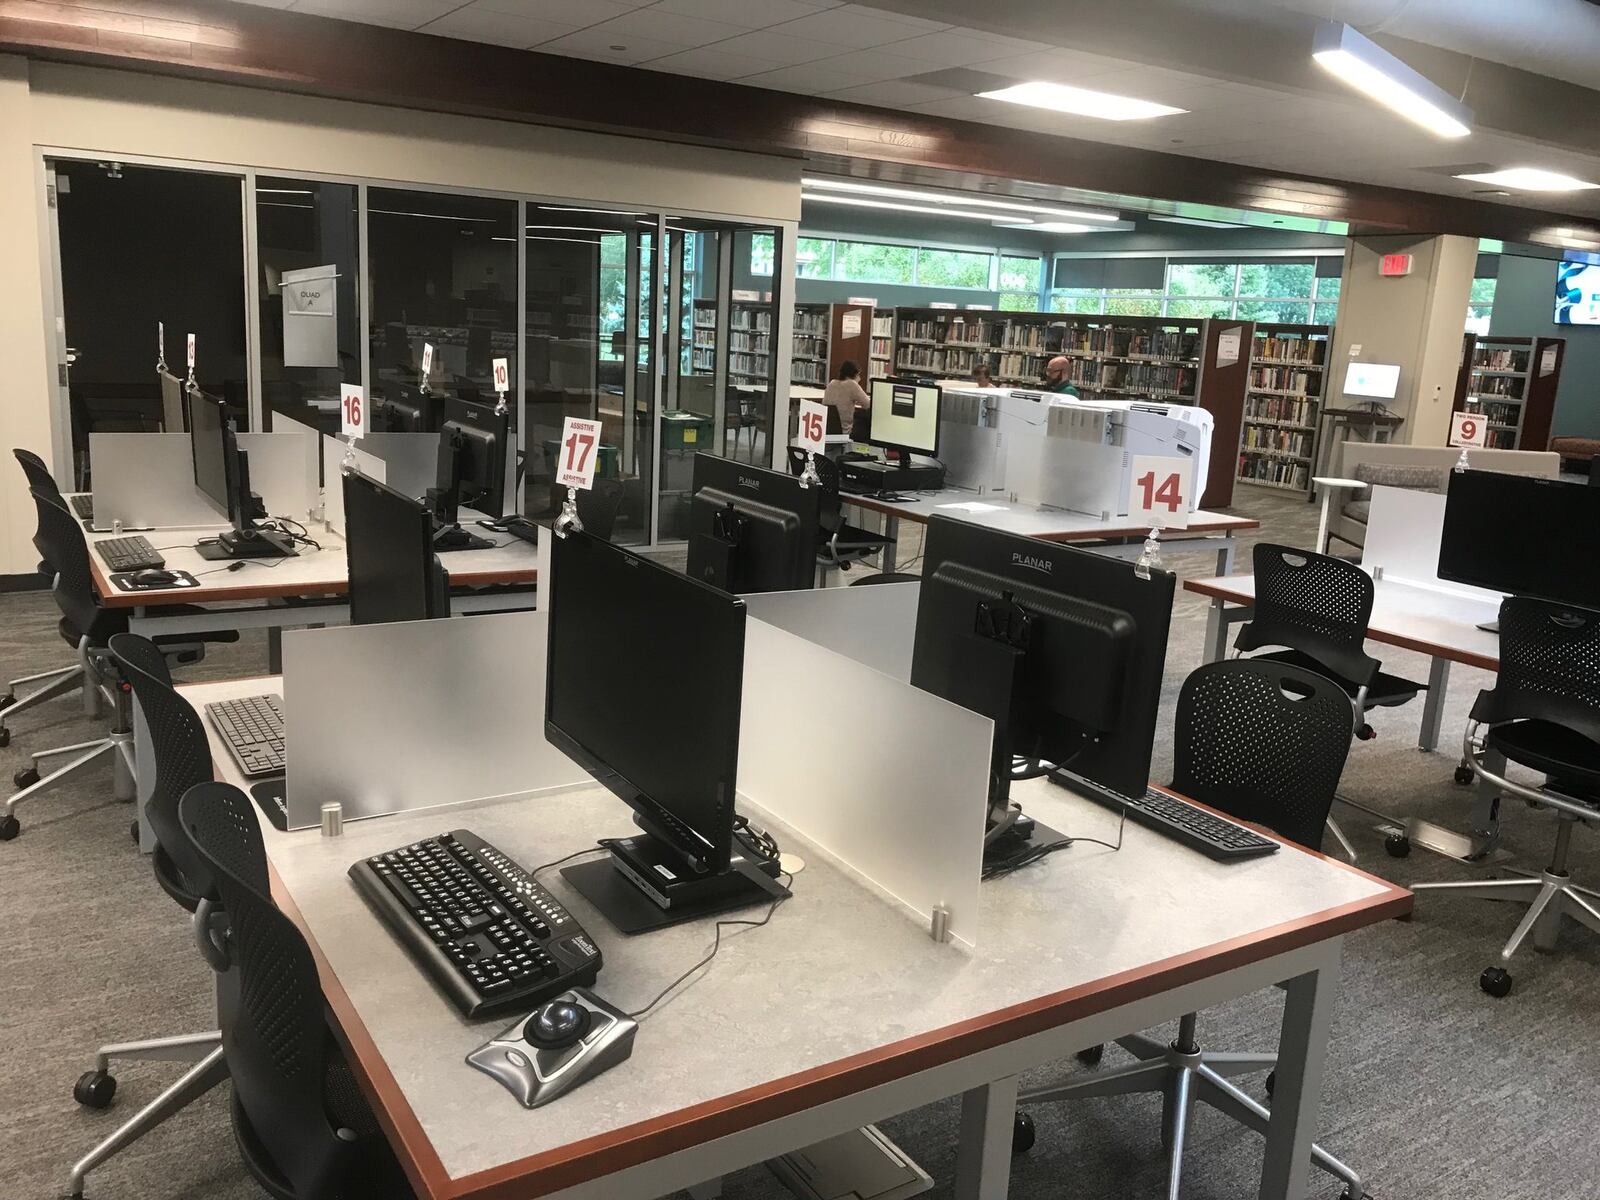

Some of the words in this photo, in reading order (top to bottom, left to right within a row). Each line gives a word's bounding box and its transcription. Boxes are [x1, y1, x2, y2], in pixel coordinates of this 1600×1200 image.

[300, 291, 321, 299] QUAD
[495, 365, 506, 384] 10
[343, 395, 361, 426] 16
[570, 421, 595, 432] ASSISTIVE
[802, 411, 823, 442] 15
[1461, 420, 1477, 440] 9
[565, 433, 595, 473] 17
[739, 476, 760, 487] PLANAR
[1137, 471, 1183, 512] 14
[1012, 552, 1053, 573] PLANAR
[573, 935, 597, 955] ZoomText
